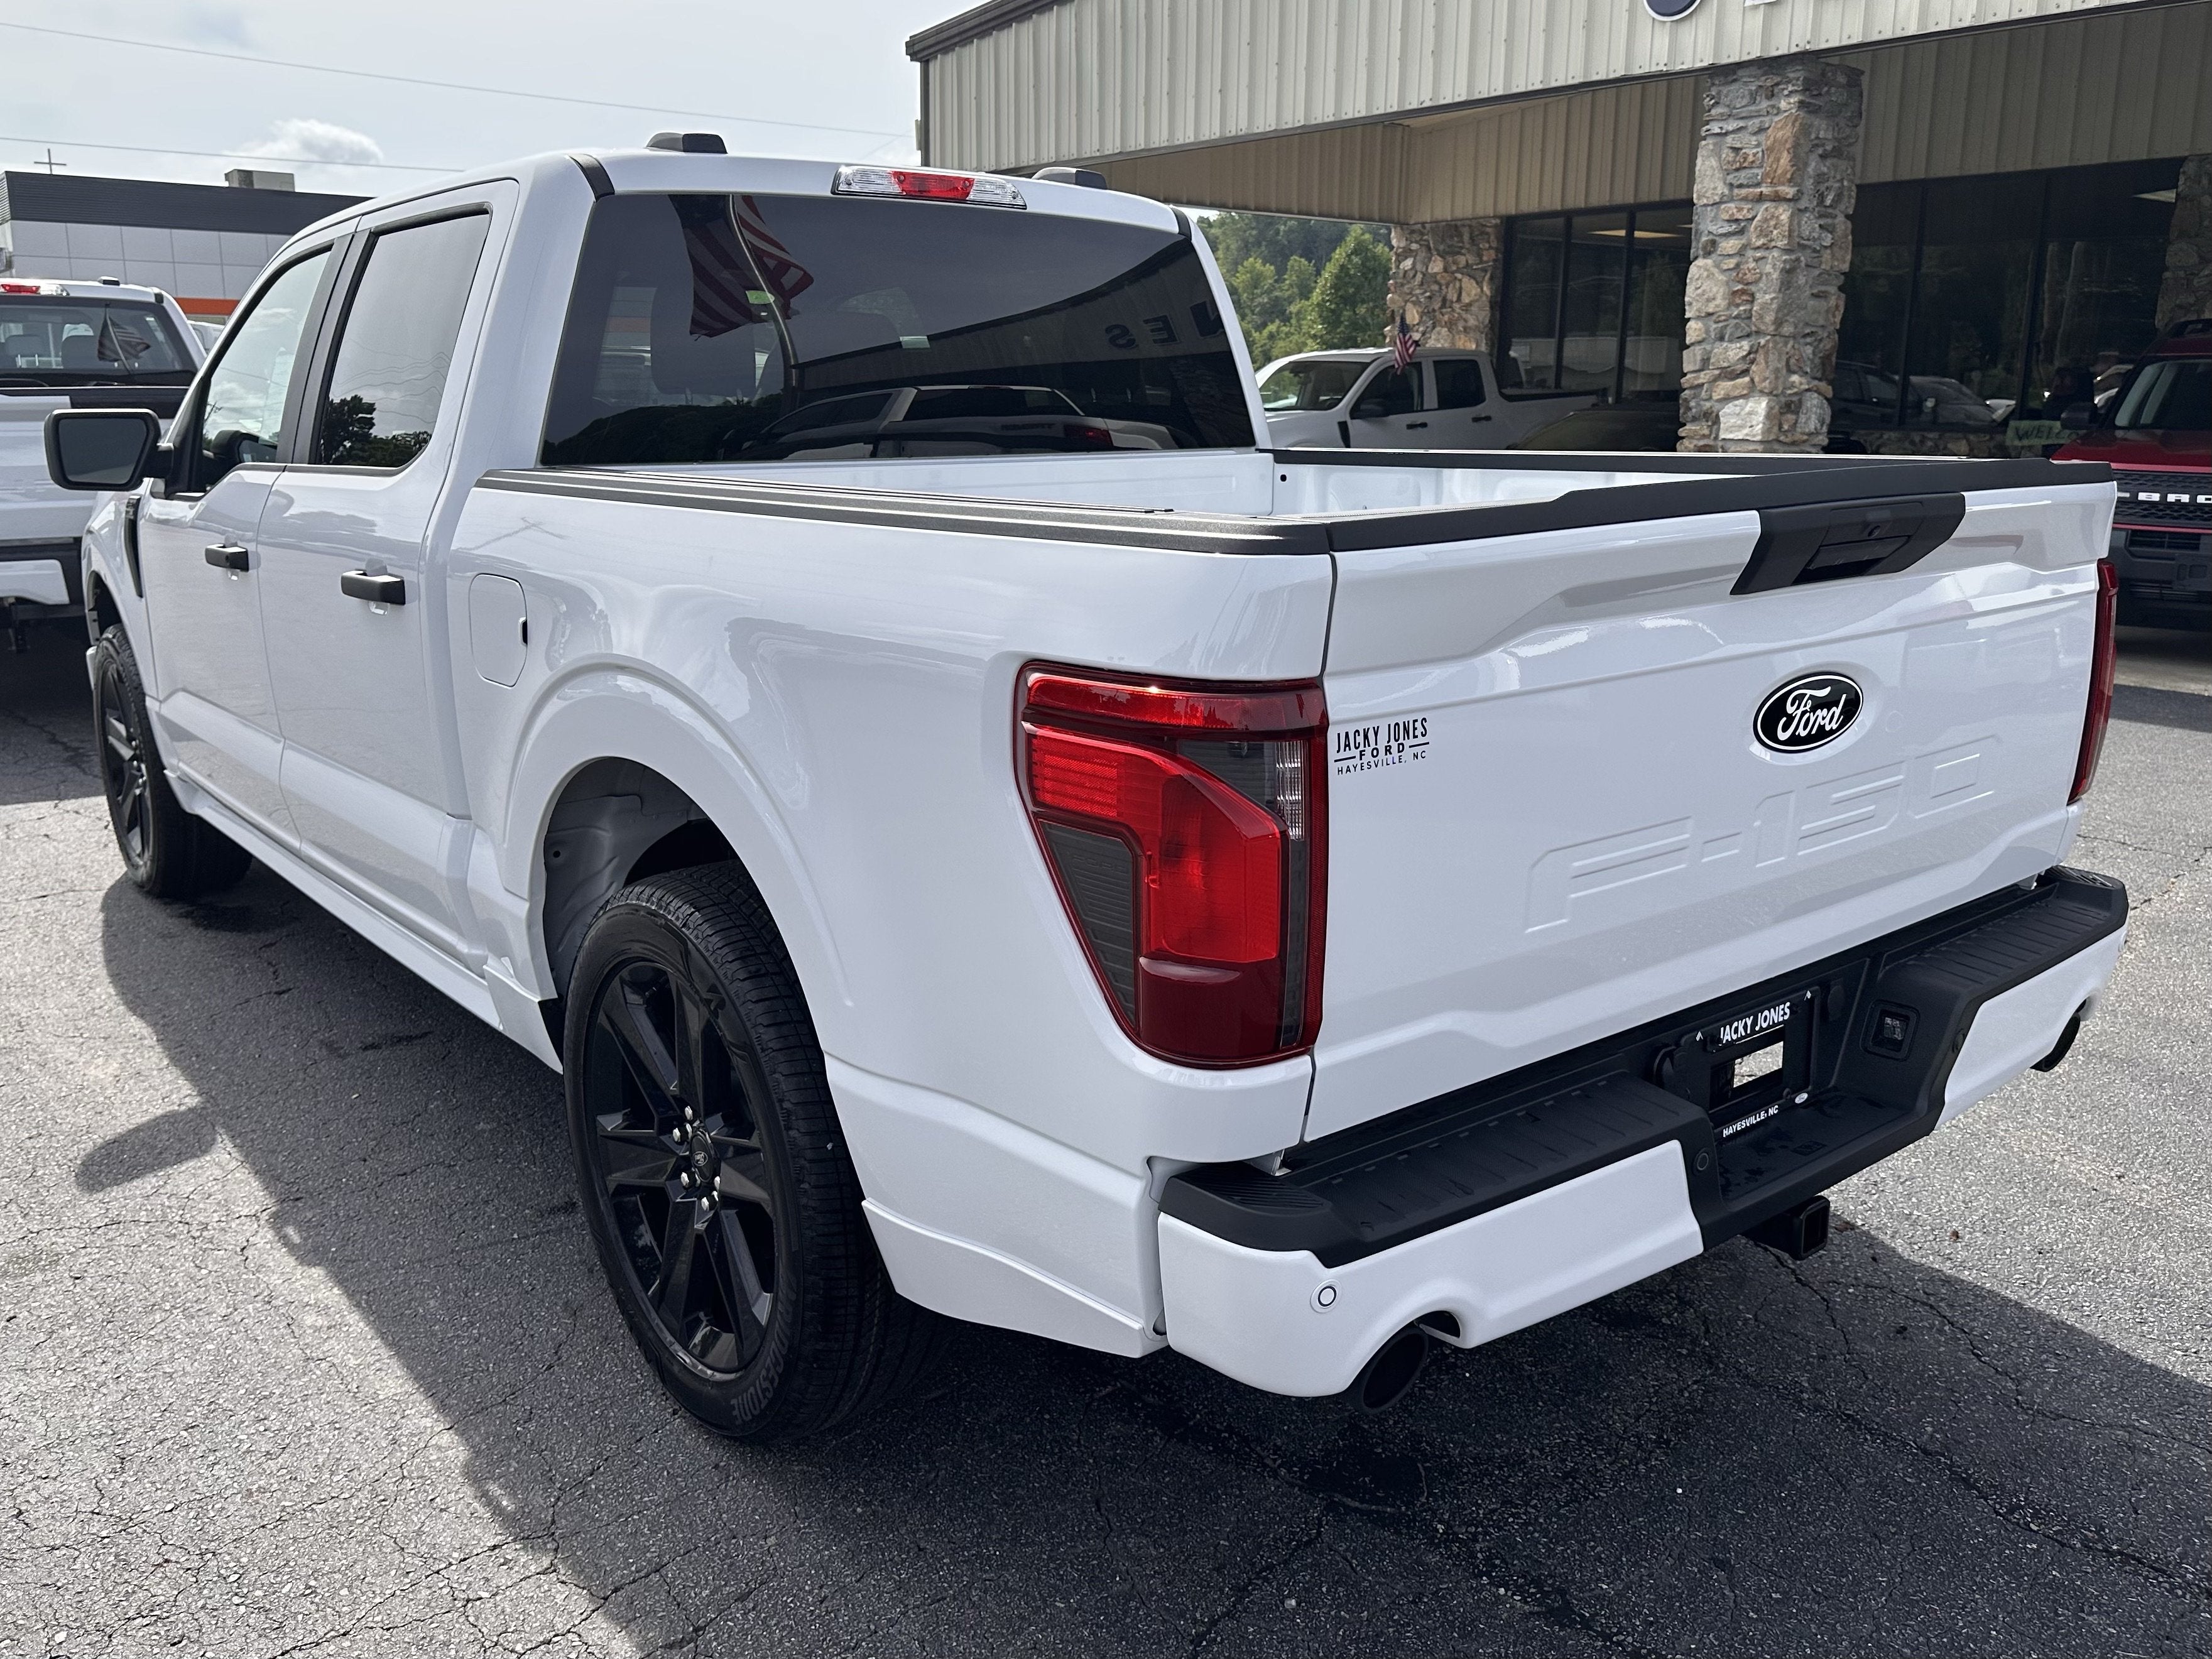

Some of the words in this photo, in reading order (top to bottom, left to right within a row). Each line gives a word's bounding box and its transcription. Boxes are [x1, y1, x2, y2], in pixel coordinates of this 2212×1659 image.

[1777, 686, 1846, 741] Ford
[1336, 726, 1380, 753] JACKY
[1387, 717, 1427, 744] JONES
[1359, 742, 1405, 761] FORD
[1337, 755, 1407, 776] HAYESVILLE,
[1413, 751, 1426, 761] NC
[1523, 734, 2003, 933] F-150
[1719, 1016, 1753, 1047] JACKY
[1755, 1001, 1790, 1031] JONES
[1723, 1111, 1767, 1138] HAYESVILLE,
[1768, 1105, 1779, 1116] NC
